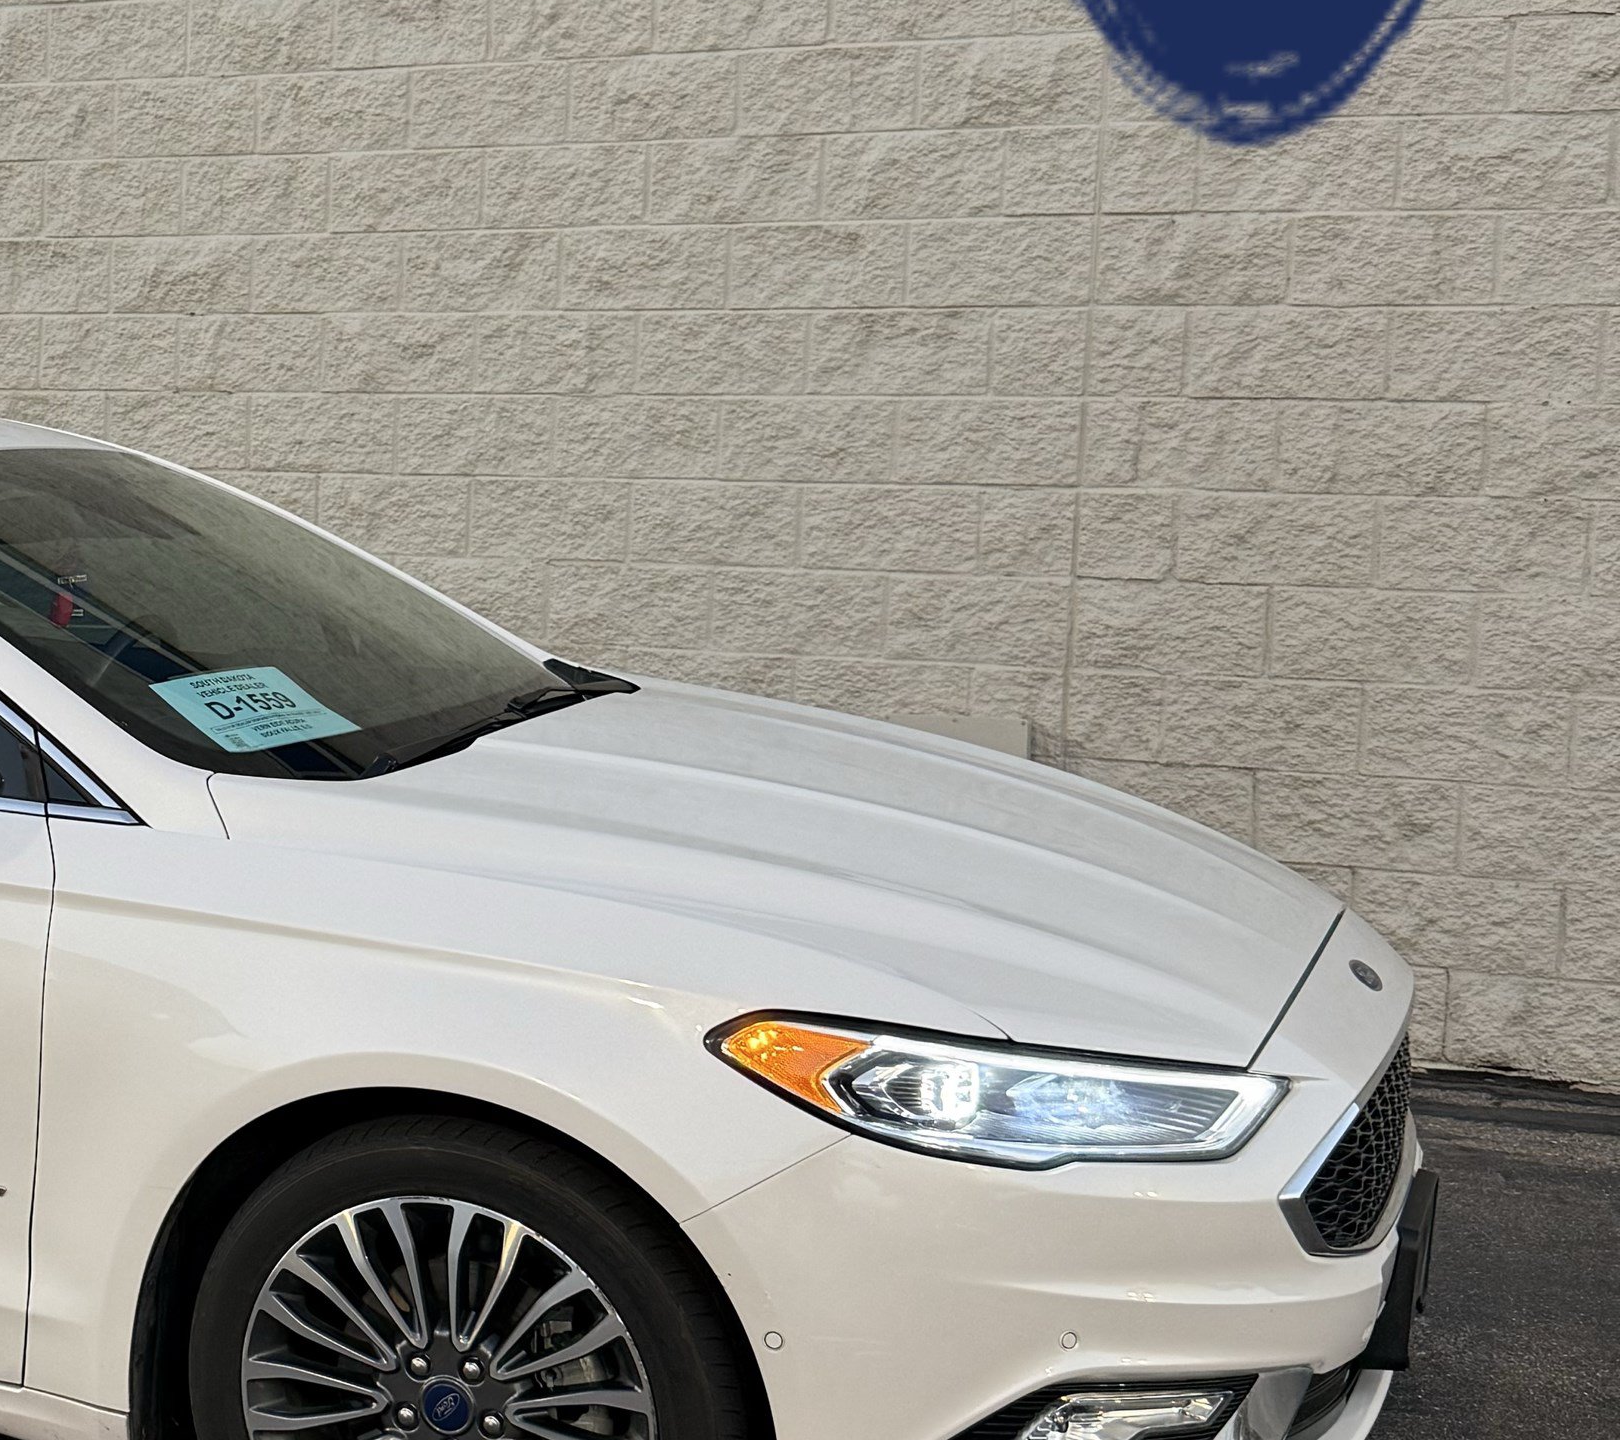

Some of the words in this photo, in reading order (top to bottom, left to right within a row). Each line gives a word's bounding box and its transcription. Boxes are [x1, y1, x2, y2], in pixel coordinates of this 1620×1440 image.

[189, 677, 222, 689] SOUTH
[220, 673, 255, 683] DAKOTA
[196, 685, 236, 698] VEHICLE
[234, 681, 269, 691] DEALER
[204, 691, 297, 720] D-1559
